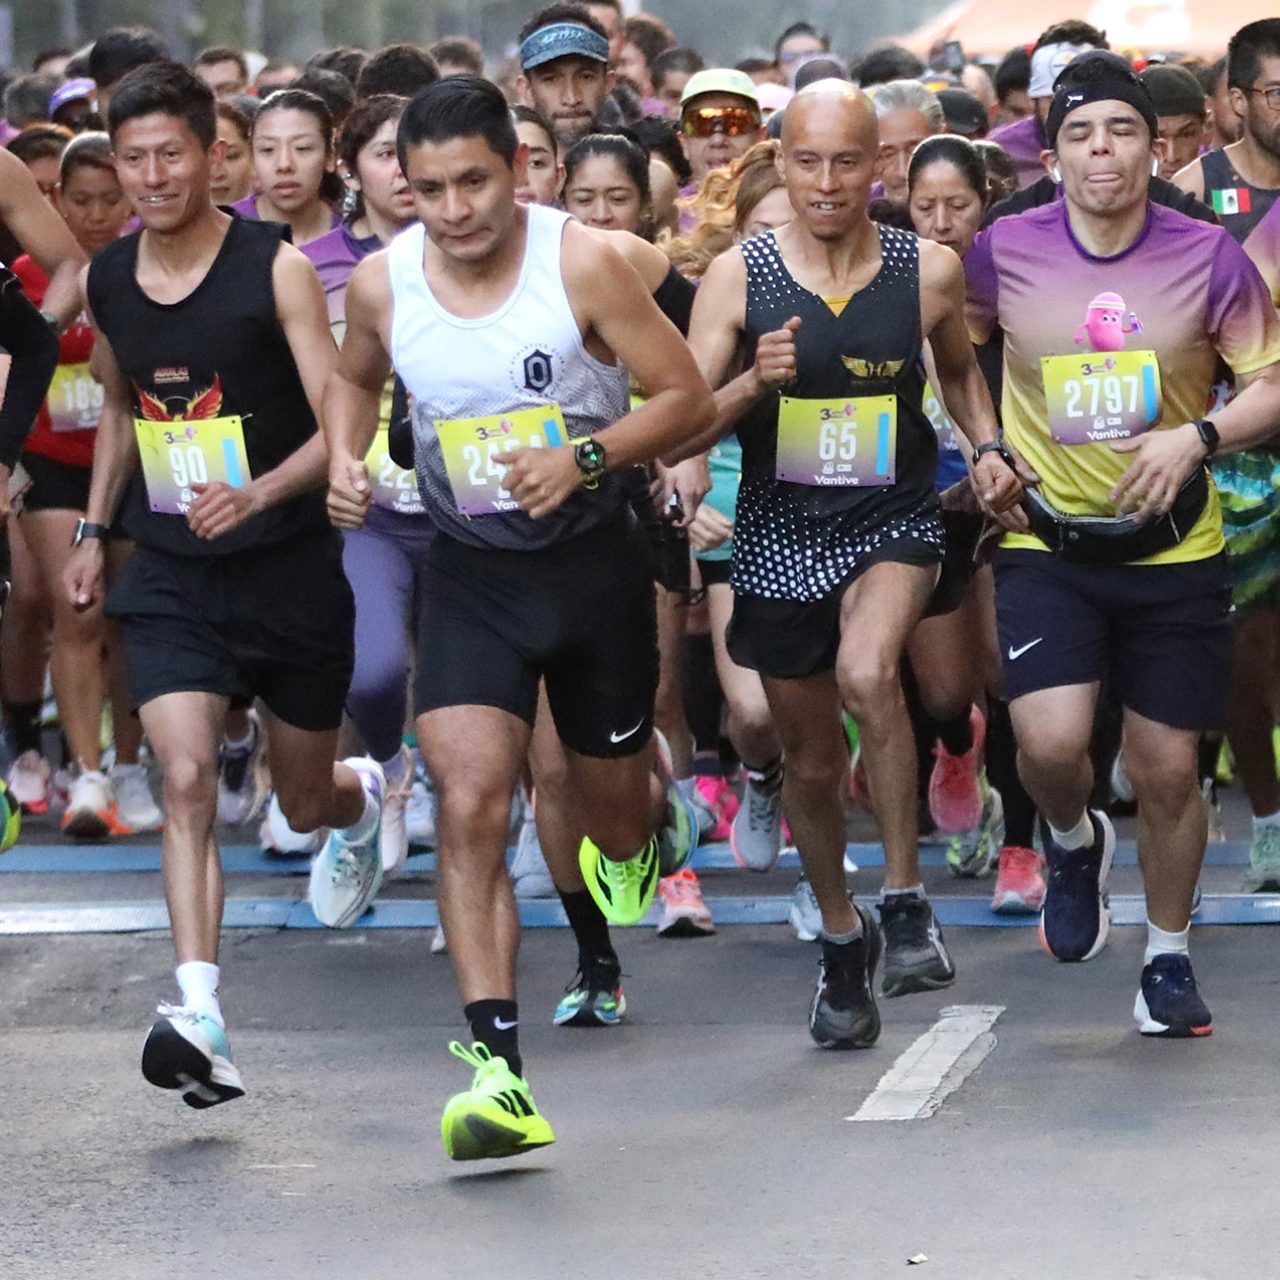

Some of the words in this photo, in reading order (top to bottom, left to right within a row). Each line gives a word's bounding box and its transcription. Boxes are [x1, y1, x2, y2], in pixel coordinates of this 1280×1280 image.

[1063, 374, 1139, 418] 2797
[818, 421, 858, 461] 65
[1086, 429, 1132, 441] Vantive
[168, 445, 208, 488] 90
[814, 474, 860, 486] Vantive
